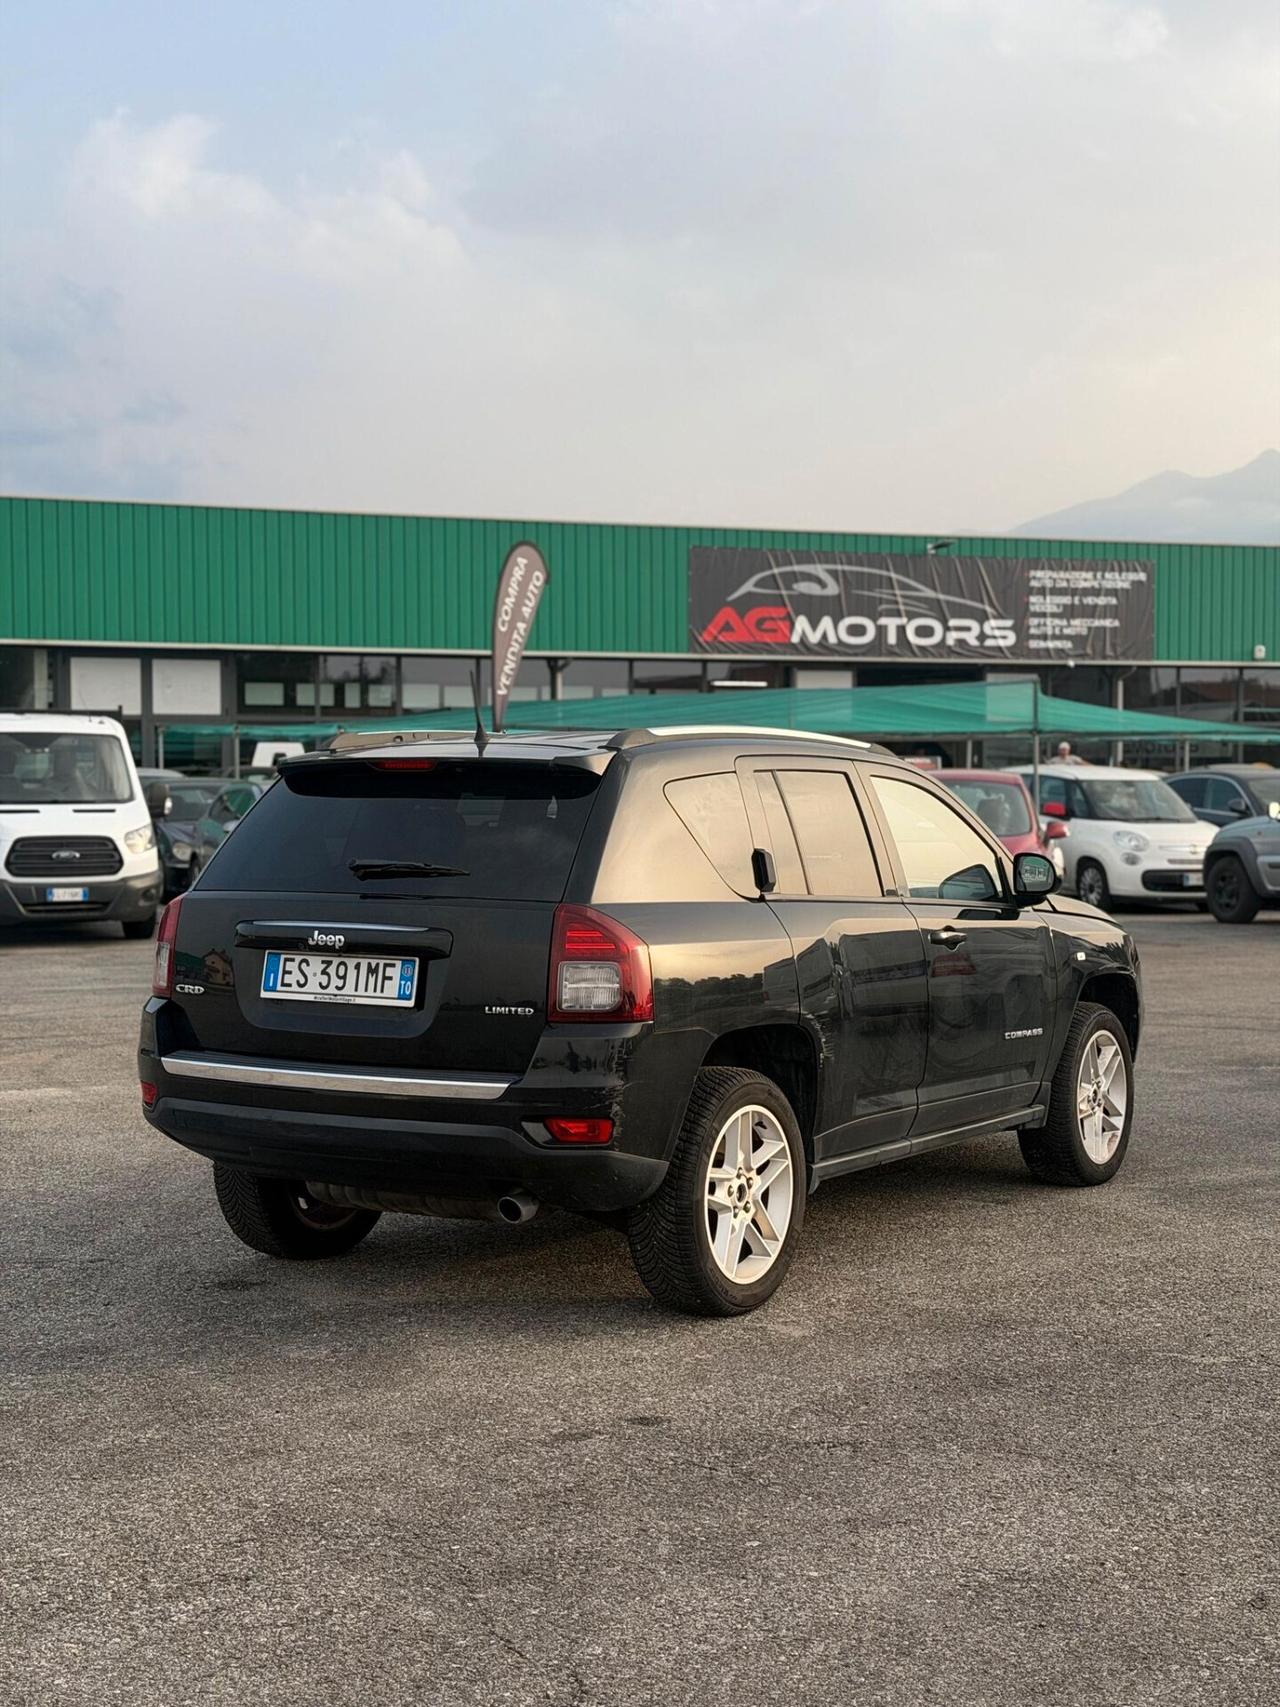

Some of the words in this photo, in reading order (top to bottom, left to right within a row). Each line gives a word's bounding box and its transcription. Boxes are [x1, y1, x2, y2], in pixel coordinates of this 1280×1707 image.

[498, 557, 529, 632] COMPRA
[497, 621, 528, 695] VENDITA
[521, 570, 544, 619] AUTO
[308, 930, 345, 949] Jeep
[280, 957, 310, 989] ES
[318, 959, 396, 994] 391MF
[176, 984, 205, 994] CRD
[400, 981, 411, 995] TO
[485, 1006, 535, 1015] LIMITED
[1004, 1028, 1043, 1039] COMPASS
